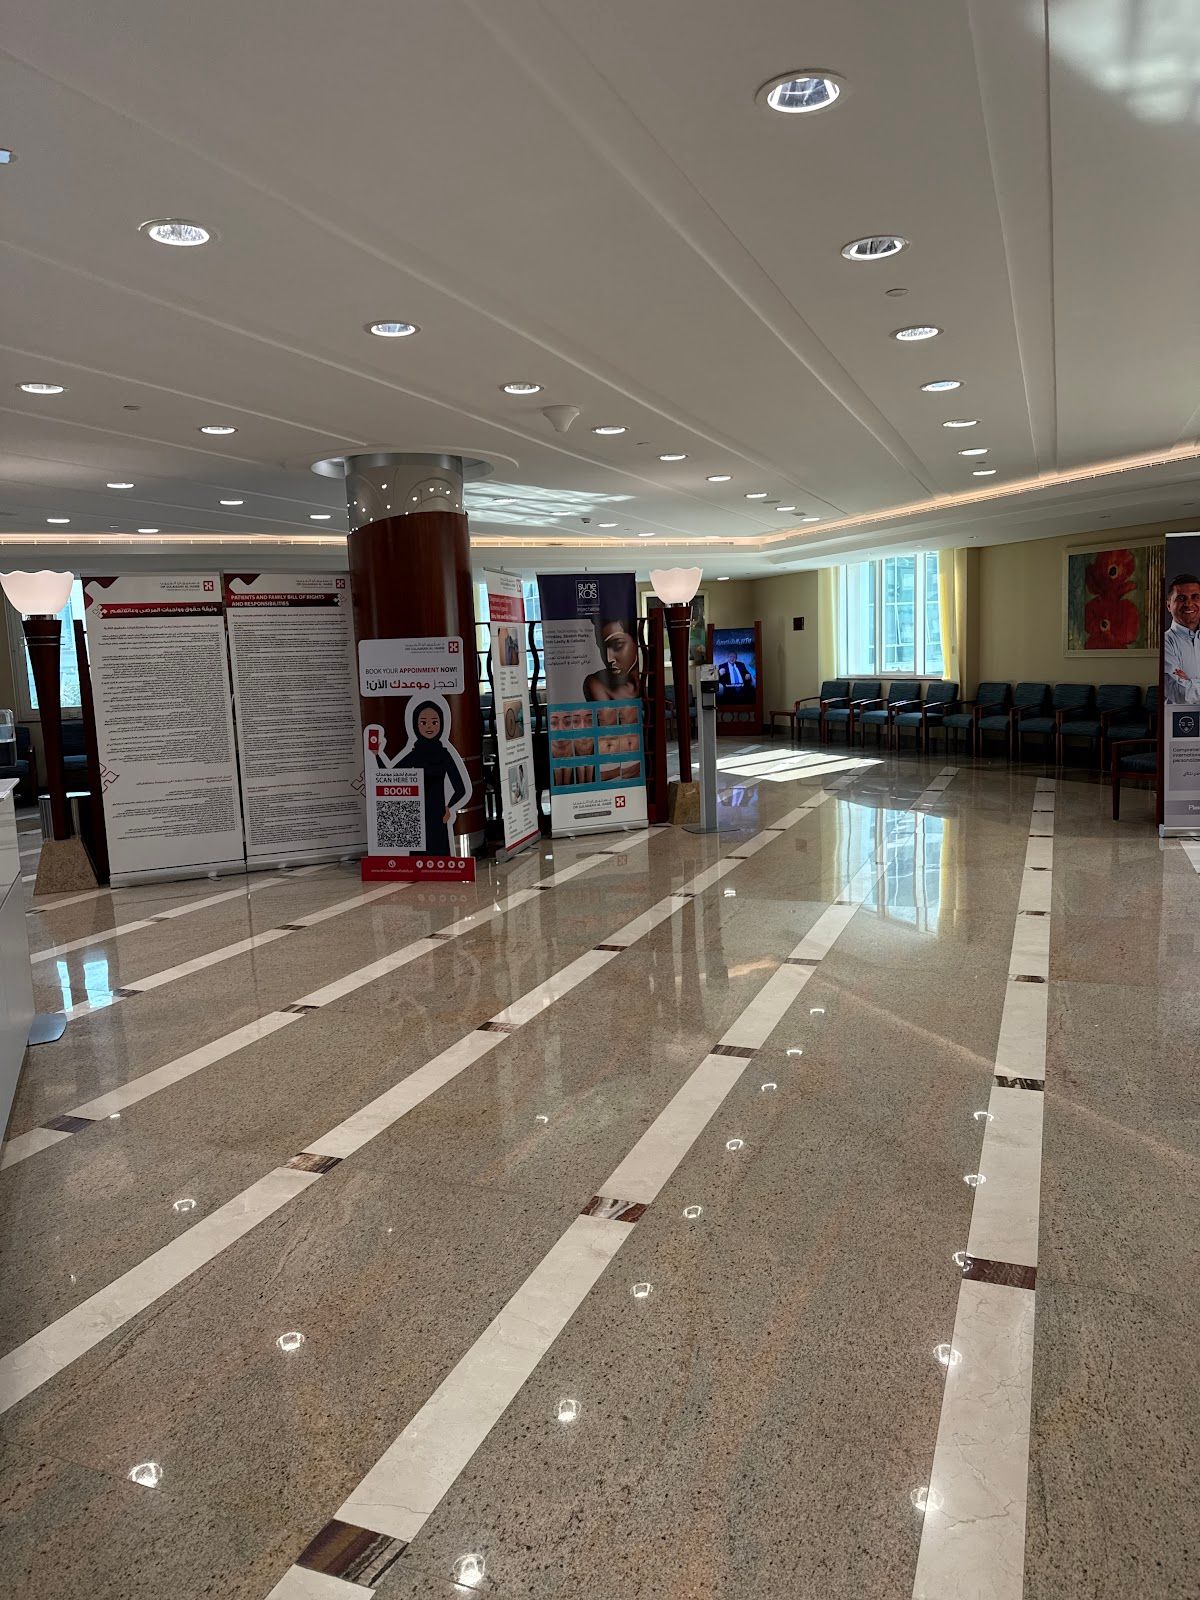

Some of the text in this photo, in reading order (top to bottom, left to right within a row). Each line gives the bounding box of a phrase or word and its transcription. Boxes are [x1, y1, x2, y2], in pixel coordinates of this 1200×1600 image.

[579, 590, 597, 599] KOS
[390, 679, 430, 690] موعدك
[383, 787, 411, 795] BOOK!
